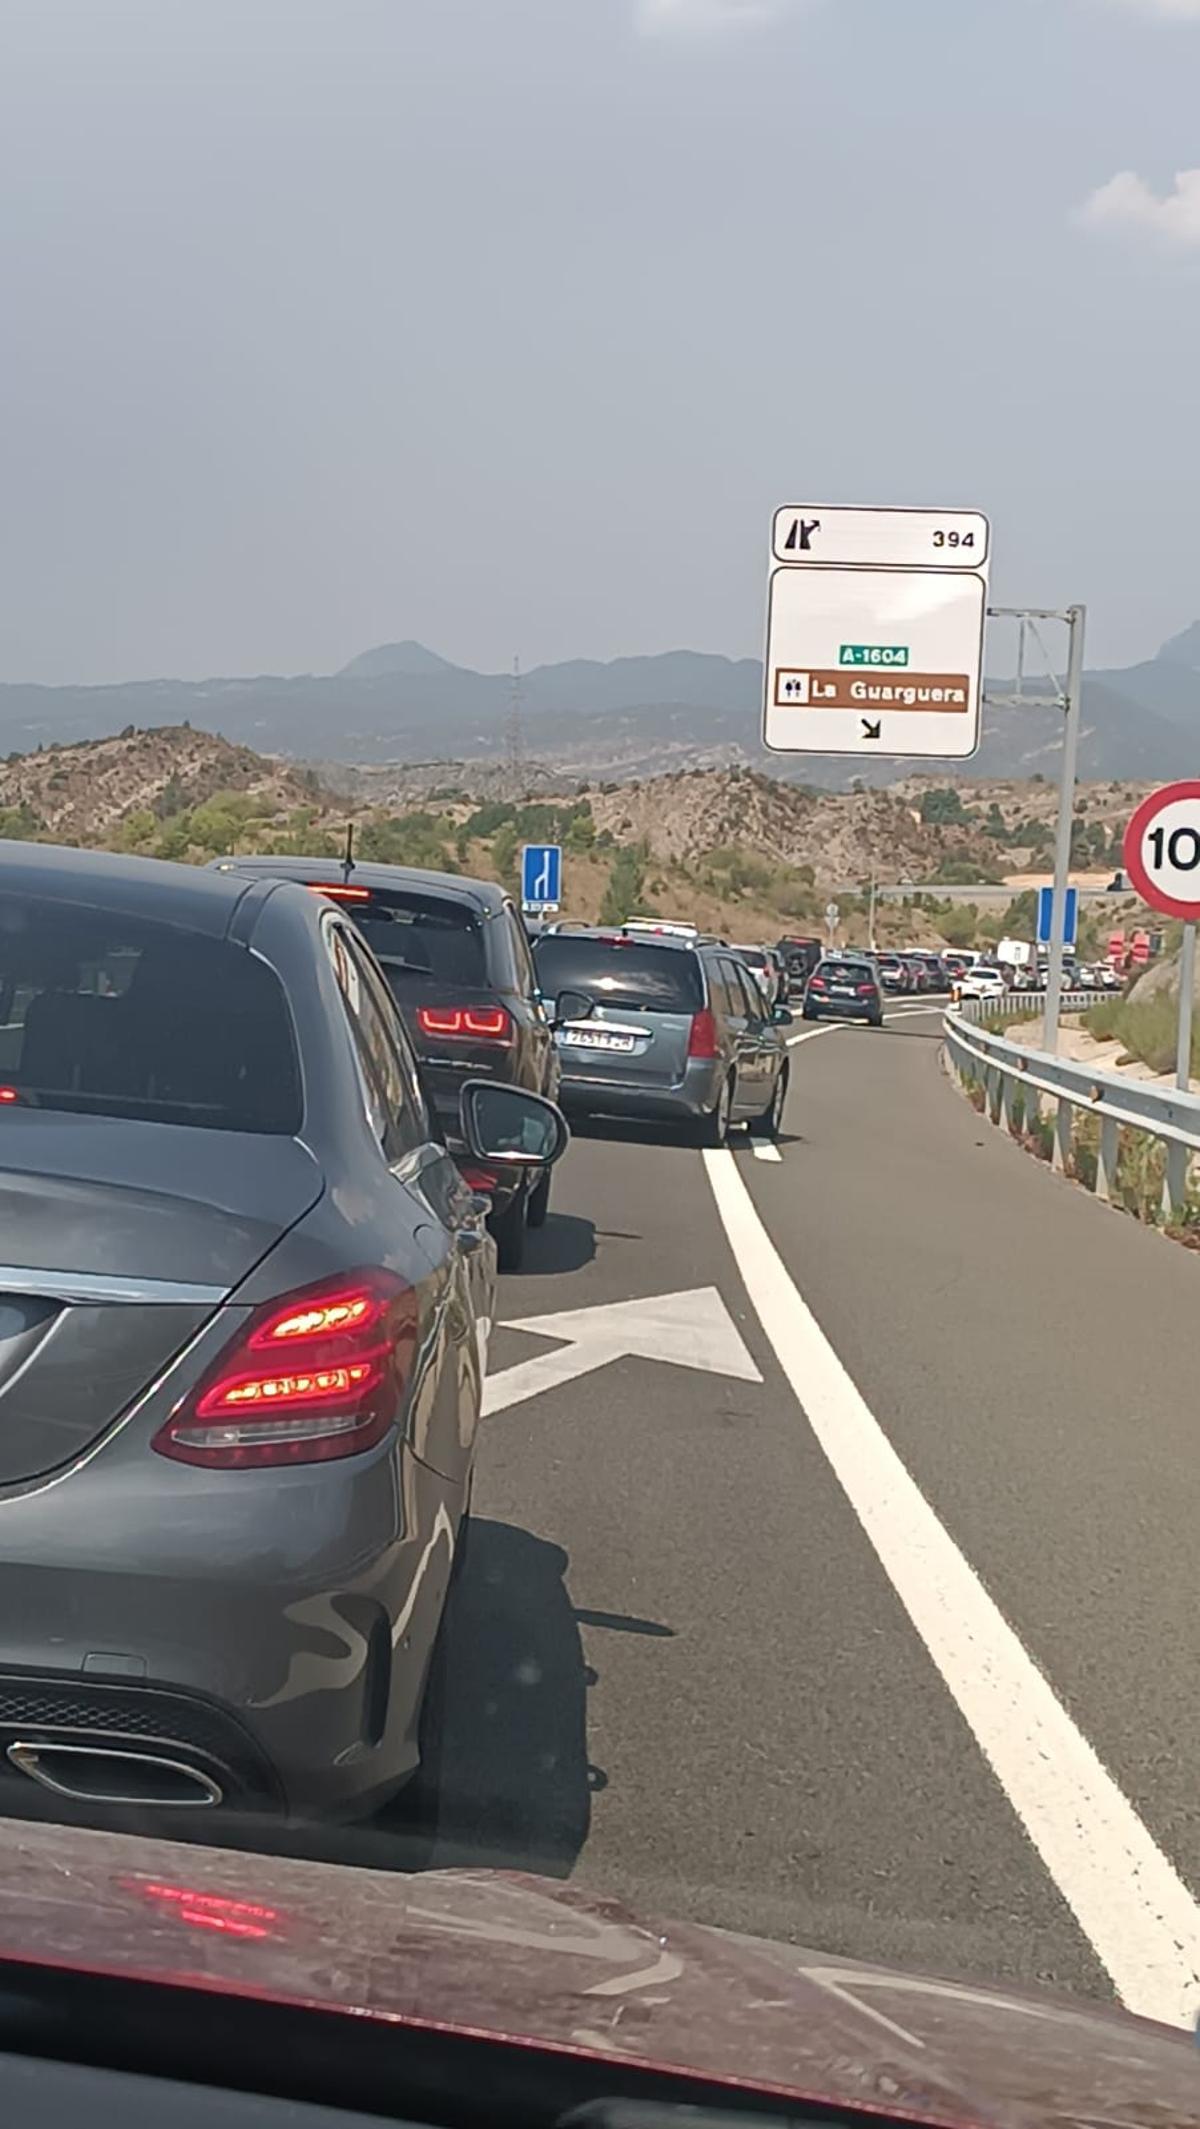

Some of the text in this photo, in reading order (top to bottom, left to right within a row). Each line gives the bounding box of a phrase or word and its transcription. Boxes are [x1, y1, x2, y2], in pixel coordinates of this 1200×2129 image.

[933, 531, 975, 548] 394
[842, 648, 906, 663] A-1604
[812, 680, 965, 704] La Guarguera
